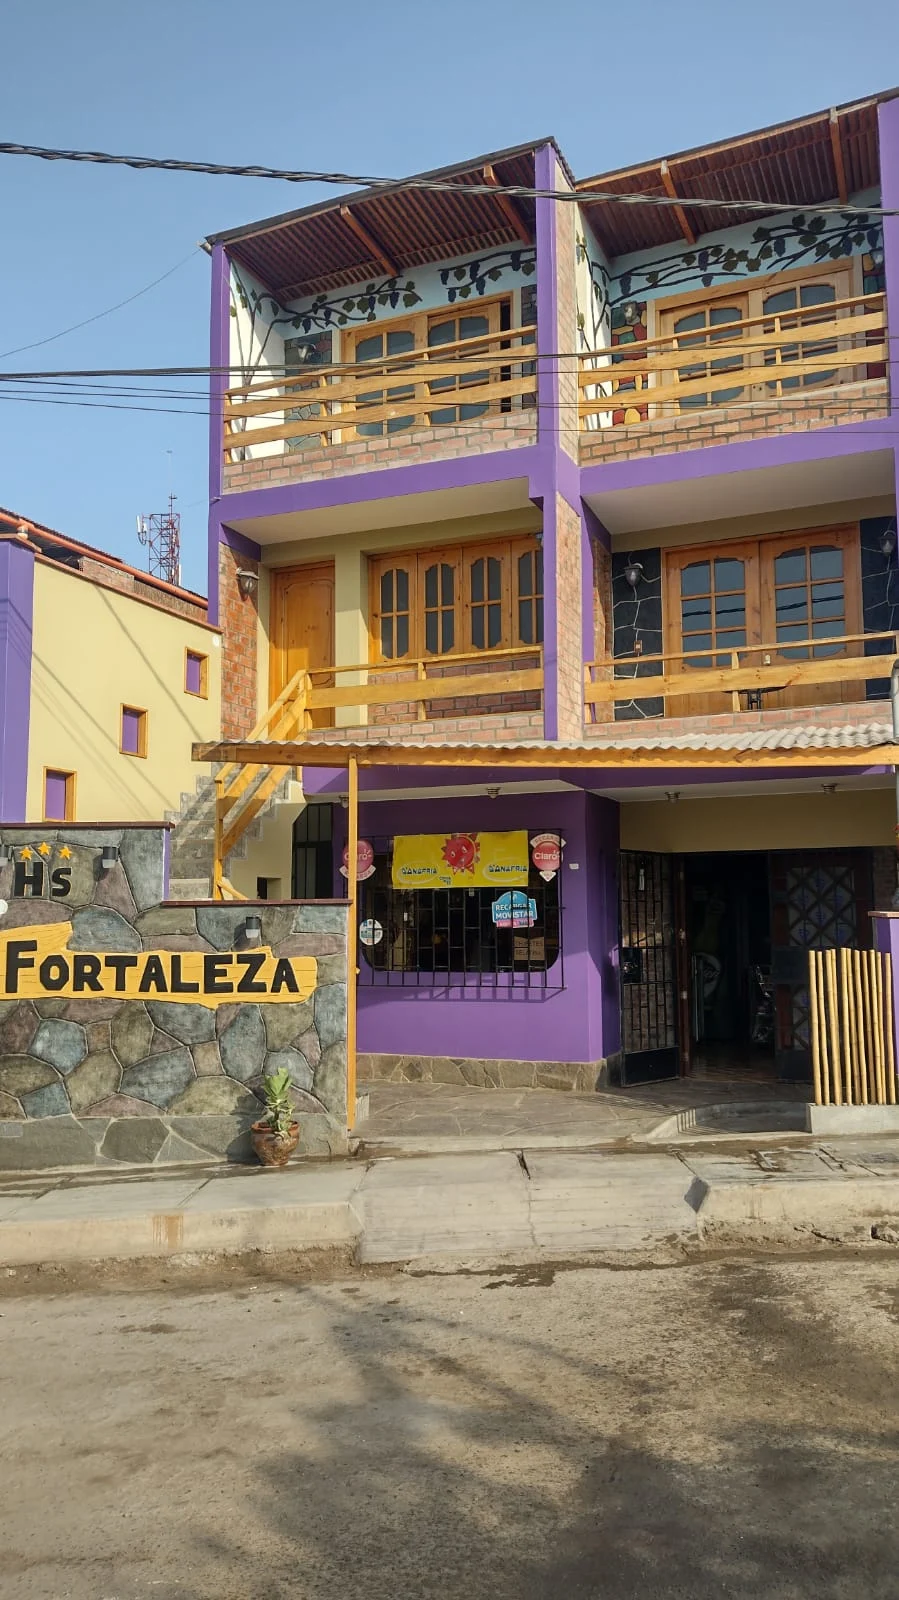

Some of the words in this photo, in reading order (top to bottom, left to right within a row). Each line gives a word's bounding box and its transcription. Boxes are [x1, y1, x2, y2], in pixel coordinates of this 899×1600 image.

[534, 850, 558, 861] Claro
[495, 910, 534, 919] MOVISTAR
[5, 940, 299, 993] FORTALEZA
